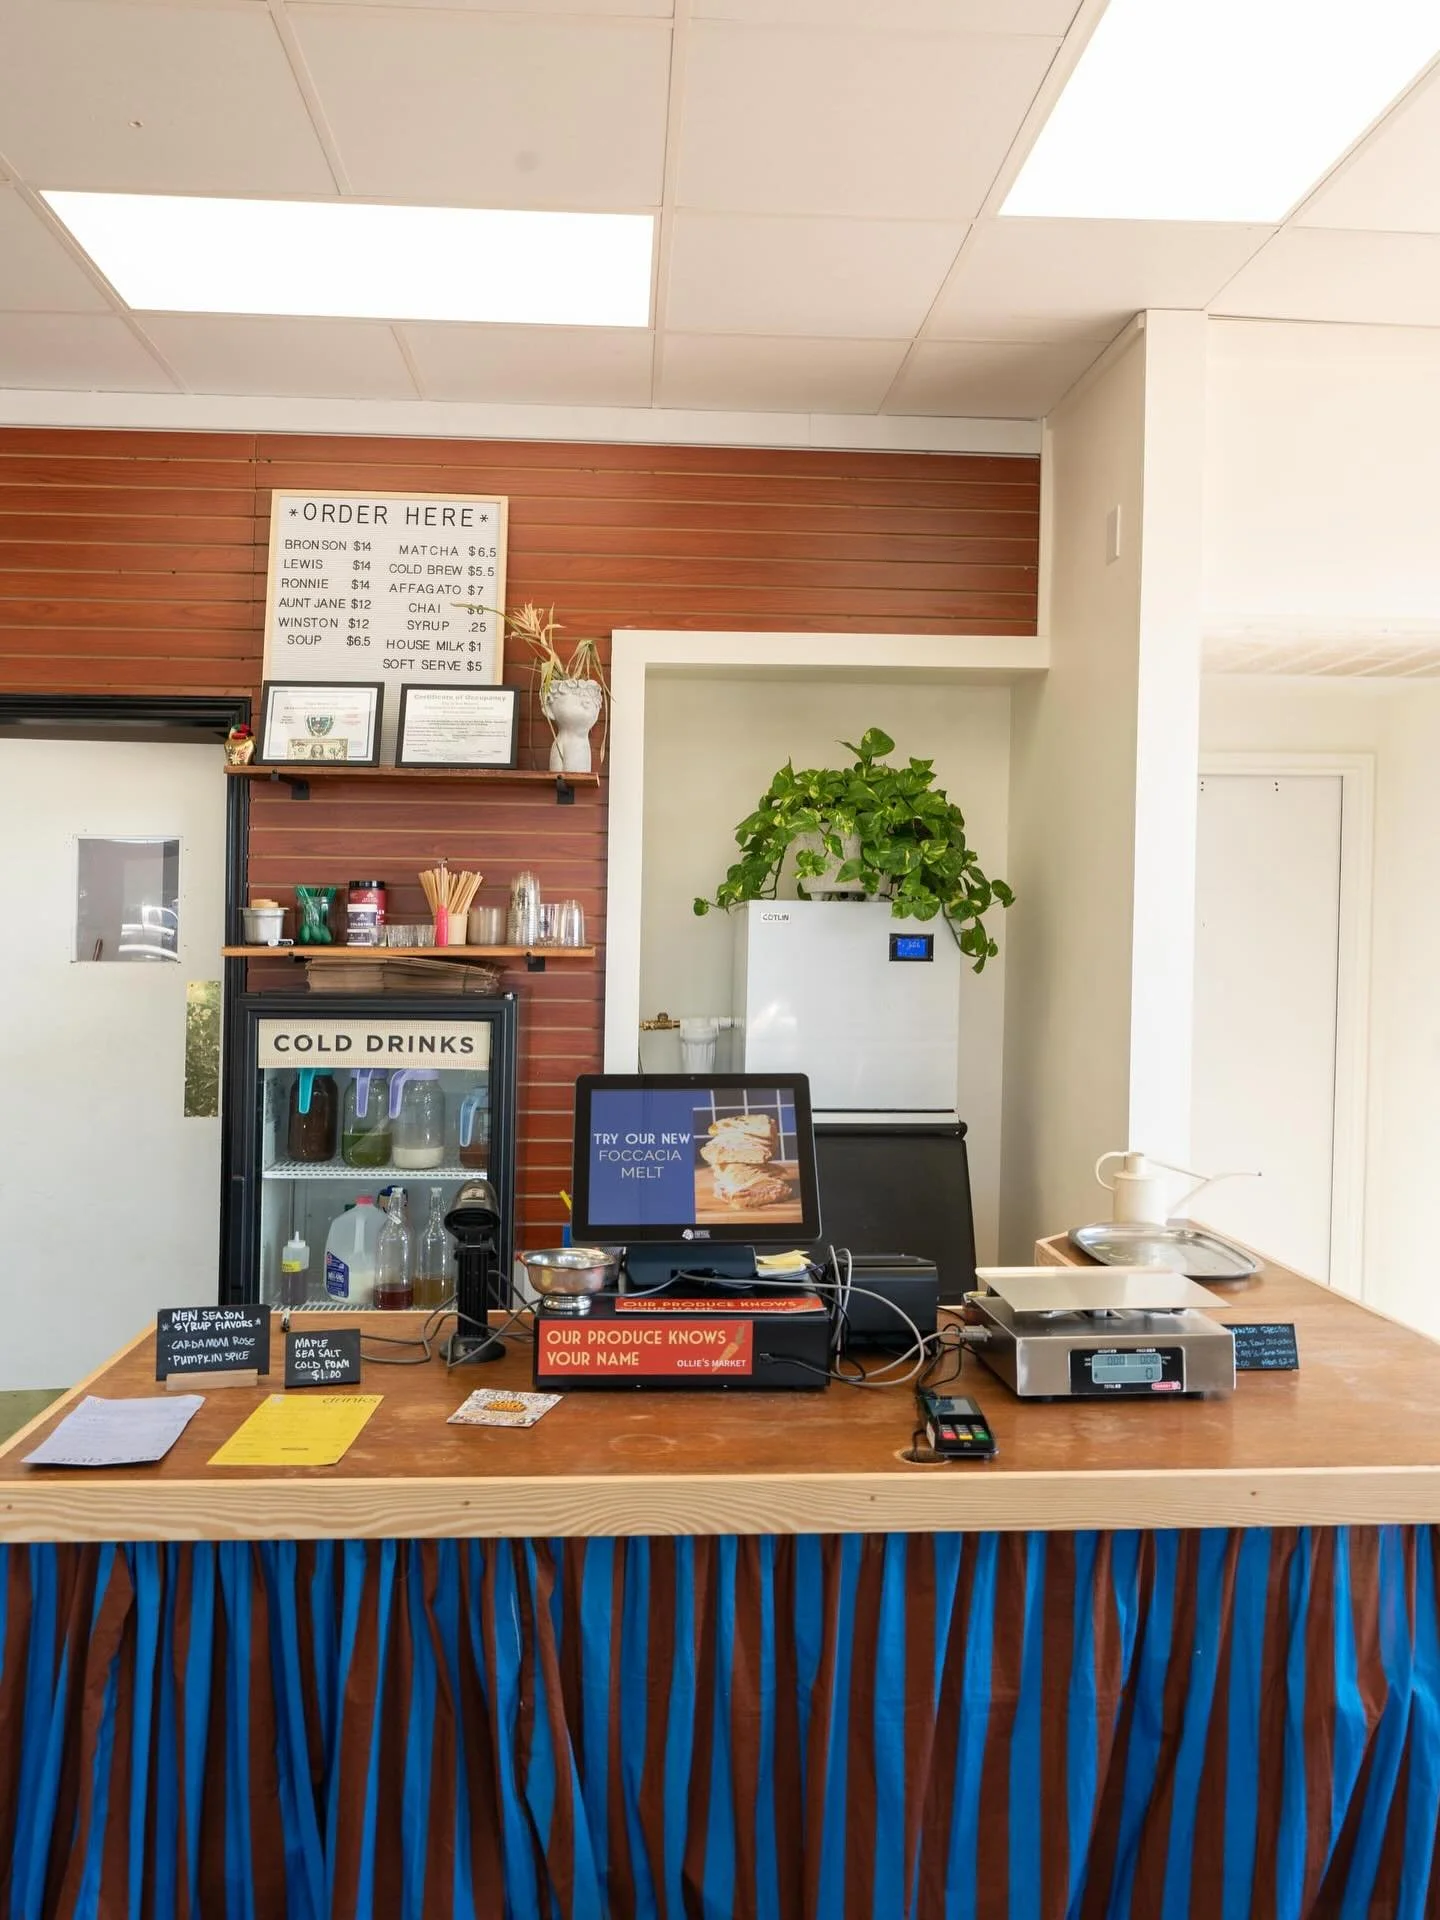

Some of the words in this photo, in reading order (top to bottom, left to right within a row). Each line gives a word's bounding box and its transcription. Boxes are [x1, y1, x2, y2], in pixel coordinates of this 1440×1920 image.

[285, 539, 347, 551] BRONSON
[353, 540, 372, 551] $14
[399, 545, 459, 557] MATCHA
[468, 545, 497, 558] $6.5
[284, 559, 323, 569] LEWIS
[352, 560, 371, 571] $14
[389, 563, 422, 575] COLD
[427, 564, 463, 576] BREW
[468, 565, 495, 577] $5.5
[281, 578, 329, 589] RONNIE
[351, 579, 370, 590] $14
[389, 583, 462, 595] AFFAGATO
[467, 585, 484, 596] $7
[279, 598, 312, 608] AUNT
[314, 598, 346, 609] JANE
[351, 599, 372, 610] $12
[408, 602, 442, 613] CHAI
[278, 617, 339, 628] WINSTON
[348, 618, 370, 629] $12
[407, 620, 450, 631] SYRUP
[287, 635, 322, 645] SOUP
[346, 636, 371, 647] $6.5
[386, 639, 431, 650] HOUSE
[436, 641, 465, 652] MILK
[468, 642, 482, 653] $1
[383, 659, 416, 670] SOFT
[421, 660, 461, 671] SERVE
[467, 661, 482, 672] $5
[273, 1034, 353, 1053] COLD
[366, 1034, 474, 1054] DRINKS
[593, 1133, 619, 1145] TRY
[625, 1133, 656, 1145] OUR
[661, 1133, 691, 1145] NEW
[599, 1149, 682, 1161] FOCCACIA
[621, 1166, 664, 1178] MELT
[202, 1311, 244, 1321] SEASON
[174, 1321, 212, 1332] SYRUP
[295, 1337, 328, 1349] MAPLE
[547, 1330, 581, 1345] OUR
[587, 1330, 663, 1345] PRODUCE
[668, 1330, 727, 1345] KNOWS
[295, 1349, 315, 1358] SEA
[318, 1348, 342, 1358] SALT
[547, 1351, 590, 1366] YOUR
[596, 1352, 640, 1366] NAME
[295, 1361, 320, 1369] COLD
[325, 1358, 350, 1369] FOAM
[677, 1358, 710, 1368] OLLIE'S
[711, 1359, 746, 1368] MARKET
[311, 1369, 341, 1381] $1.00
